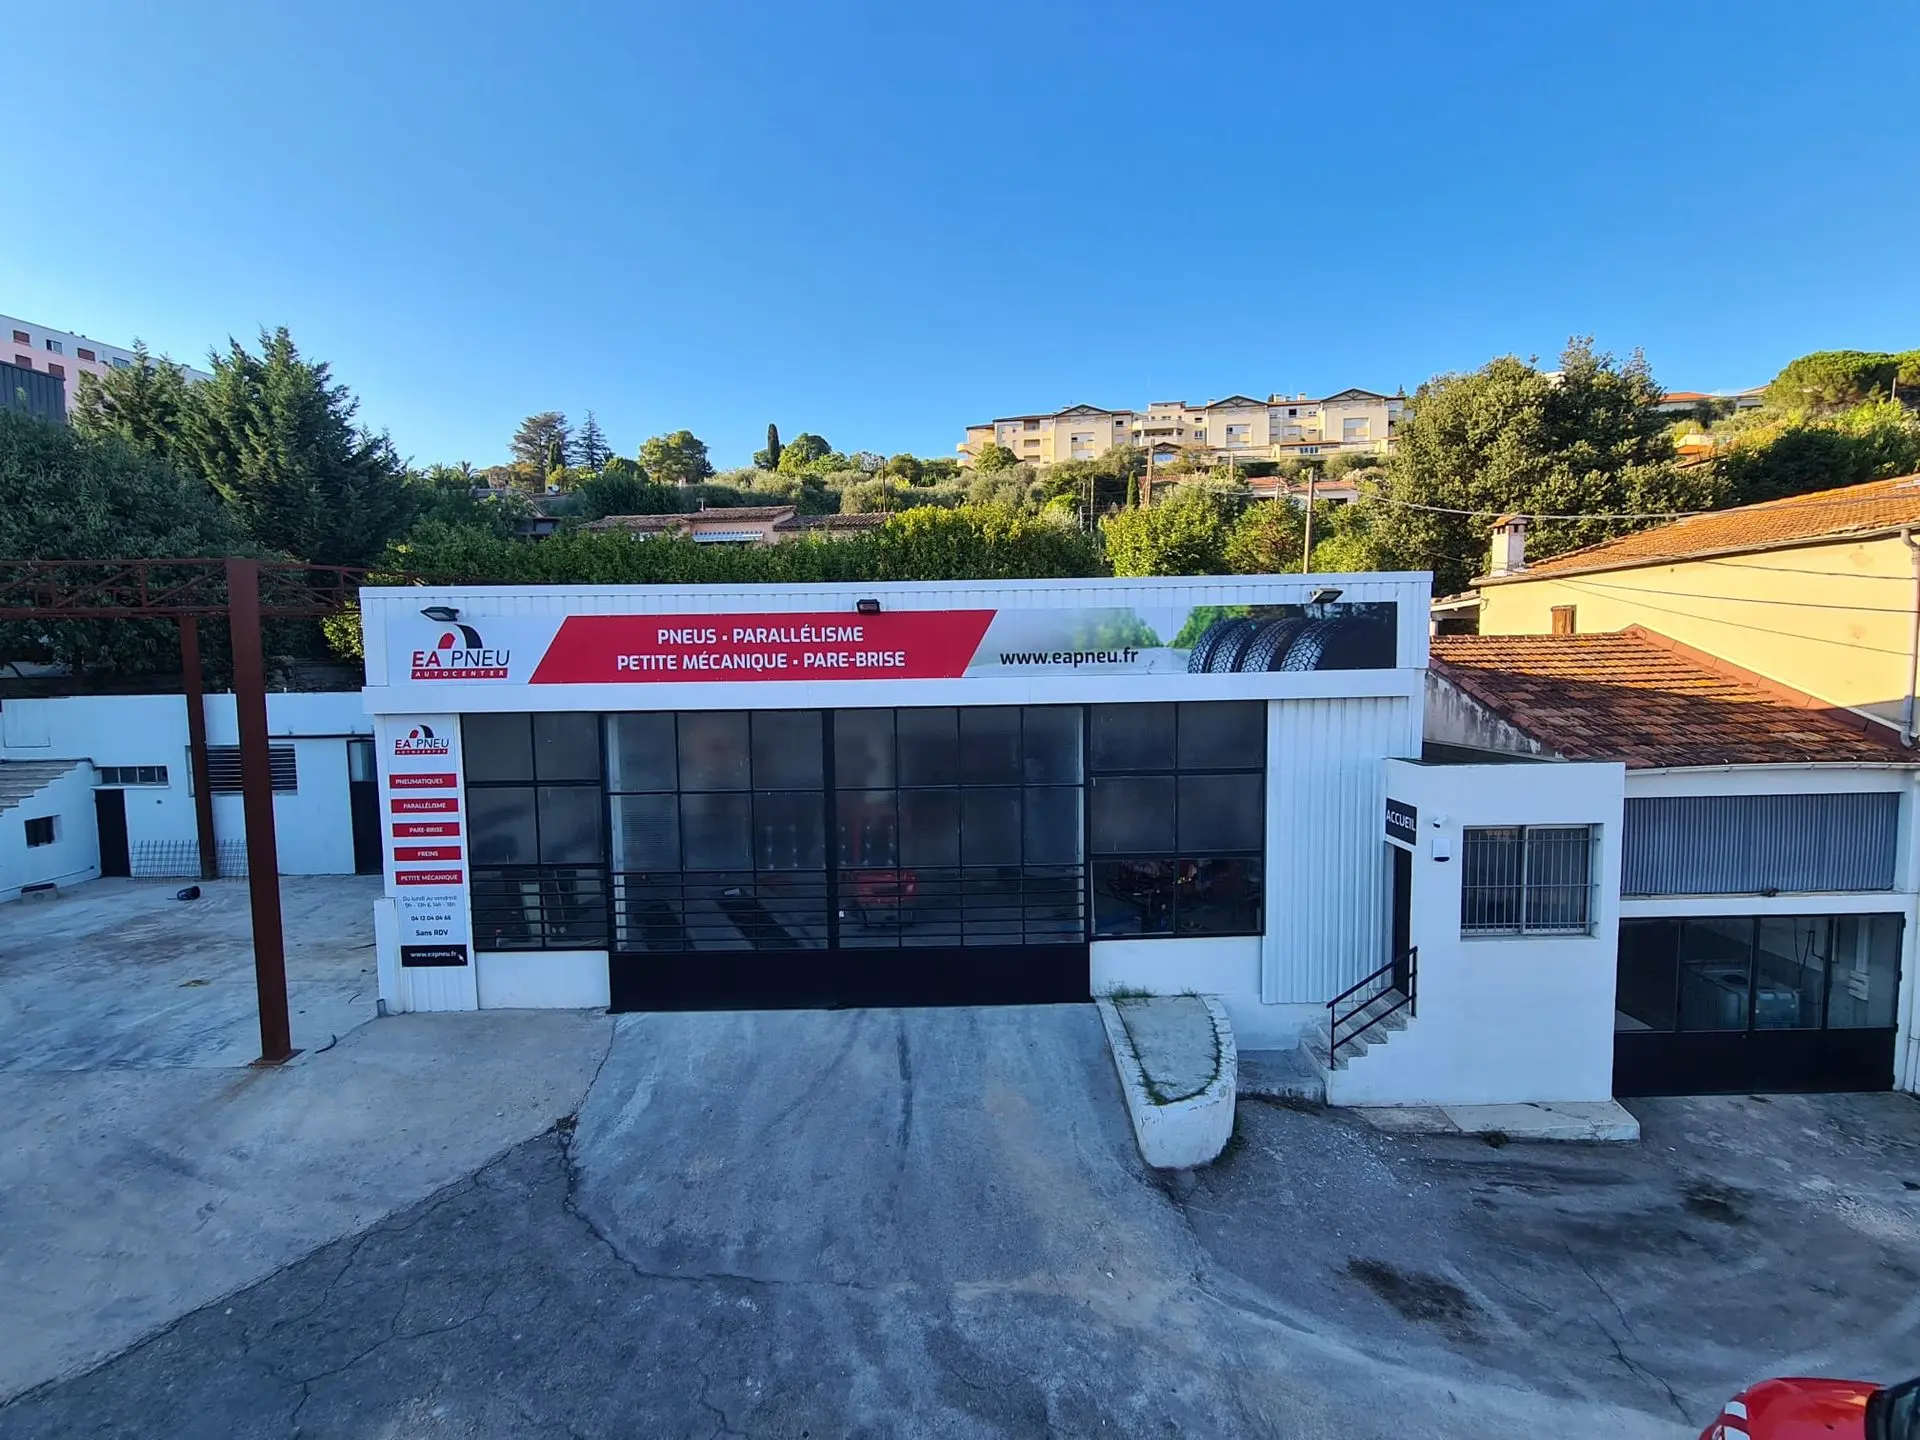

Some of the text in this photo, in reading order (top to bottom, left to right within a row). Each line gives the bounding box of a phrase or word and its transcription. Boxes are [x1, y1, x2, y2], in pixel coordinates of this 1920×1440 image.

[657, 624, 864, 645] PNEUS PARALLÉLISME
[412, 650, 510, 667] EA PNEU
[617, 651, 906, 671] PETITE MÉCANIQUE PARE-BRISE
[1000, 647, 1139, 668] www.eapneu.fr
[395, 738, 449, 749] EA PNEU
[1386, 809, 1416, 832] ACCUEIL
[421, 873, 458, 881] MÉCANIQUE
